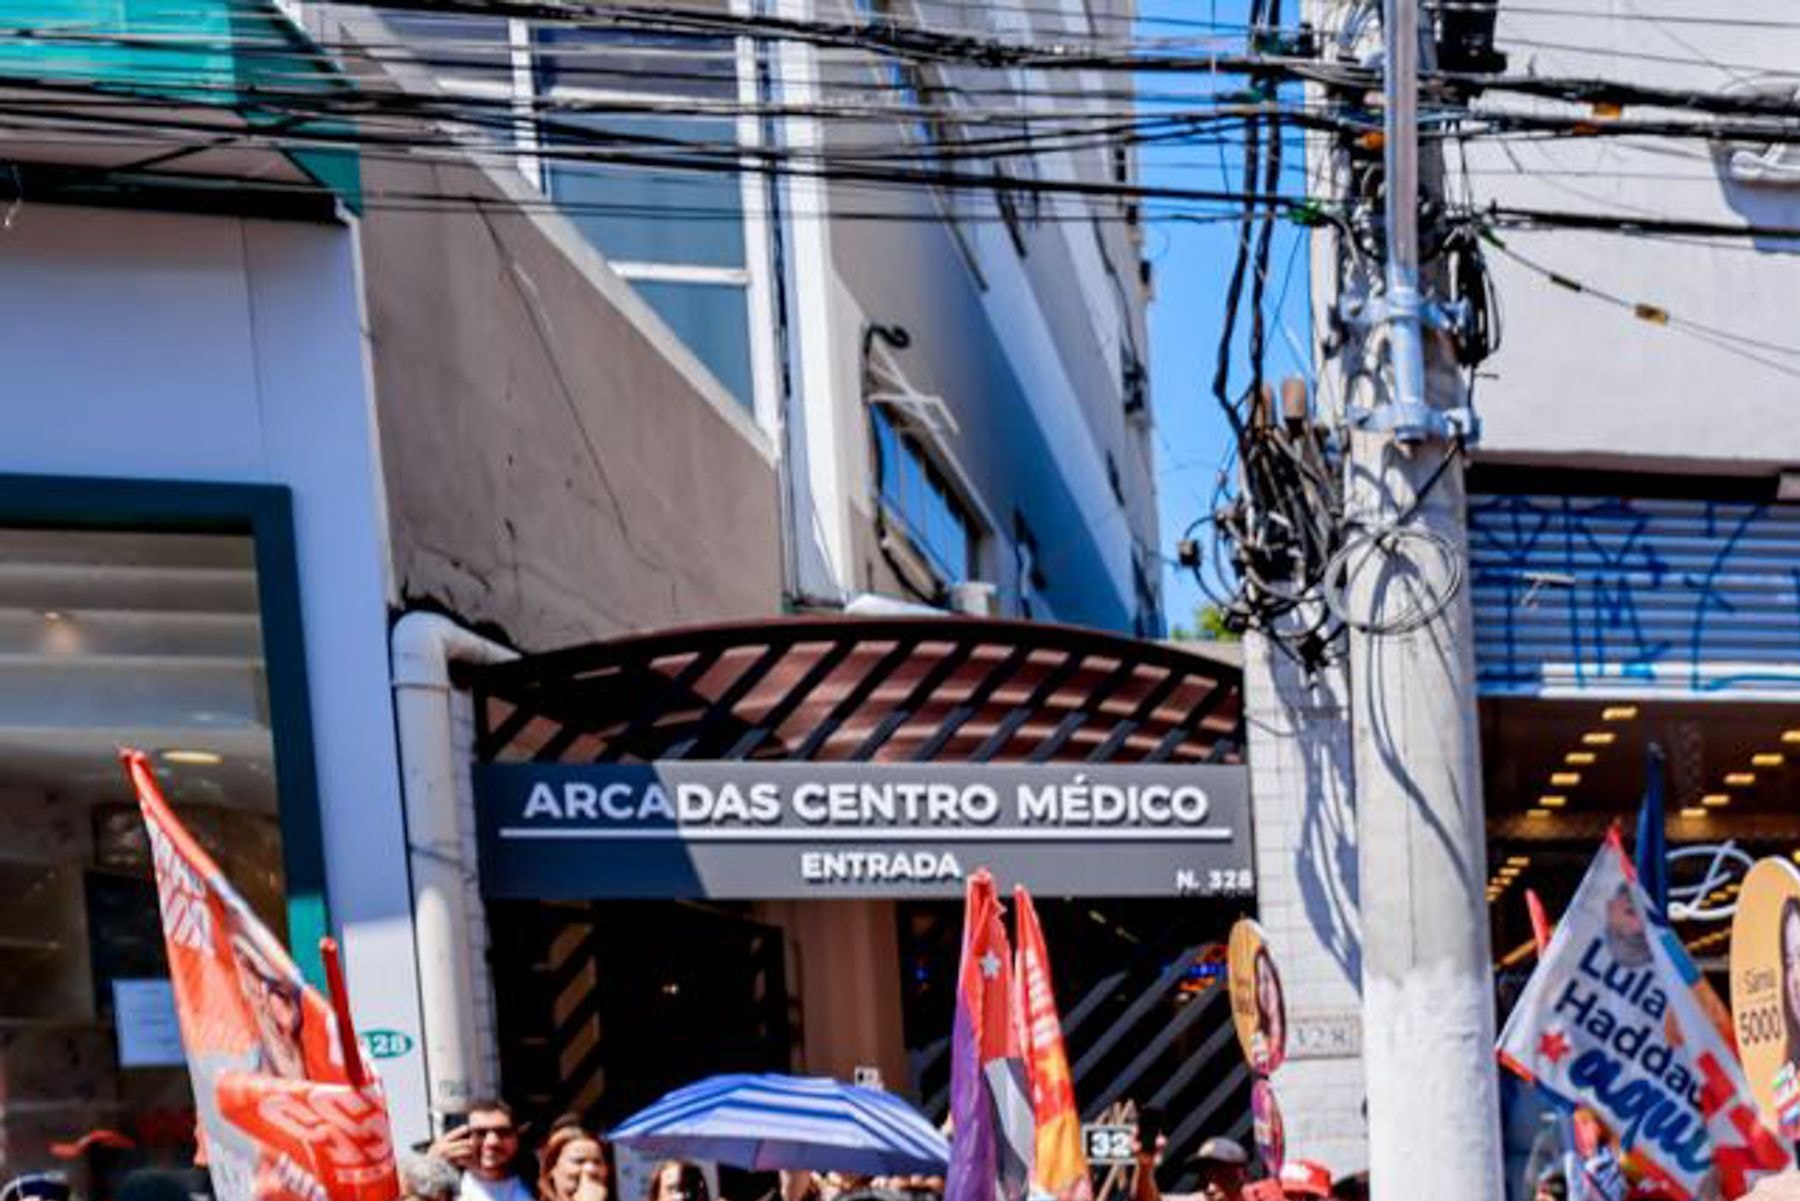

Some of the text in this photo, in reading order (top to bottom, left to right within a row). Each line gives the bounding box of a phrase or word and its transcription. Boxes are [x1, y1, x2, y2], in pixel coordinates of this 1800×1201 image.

[523, 775, 1209, 823] ARCADAS CENTRO MÉDICO
[801, 852, 962, 879] ENTRADA
[1176, 870, 1252, 889] N. 328
[1578, 938, 1669, 1020] Lula
[1739, 1004, 1781, 1046] 5000
